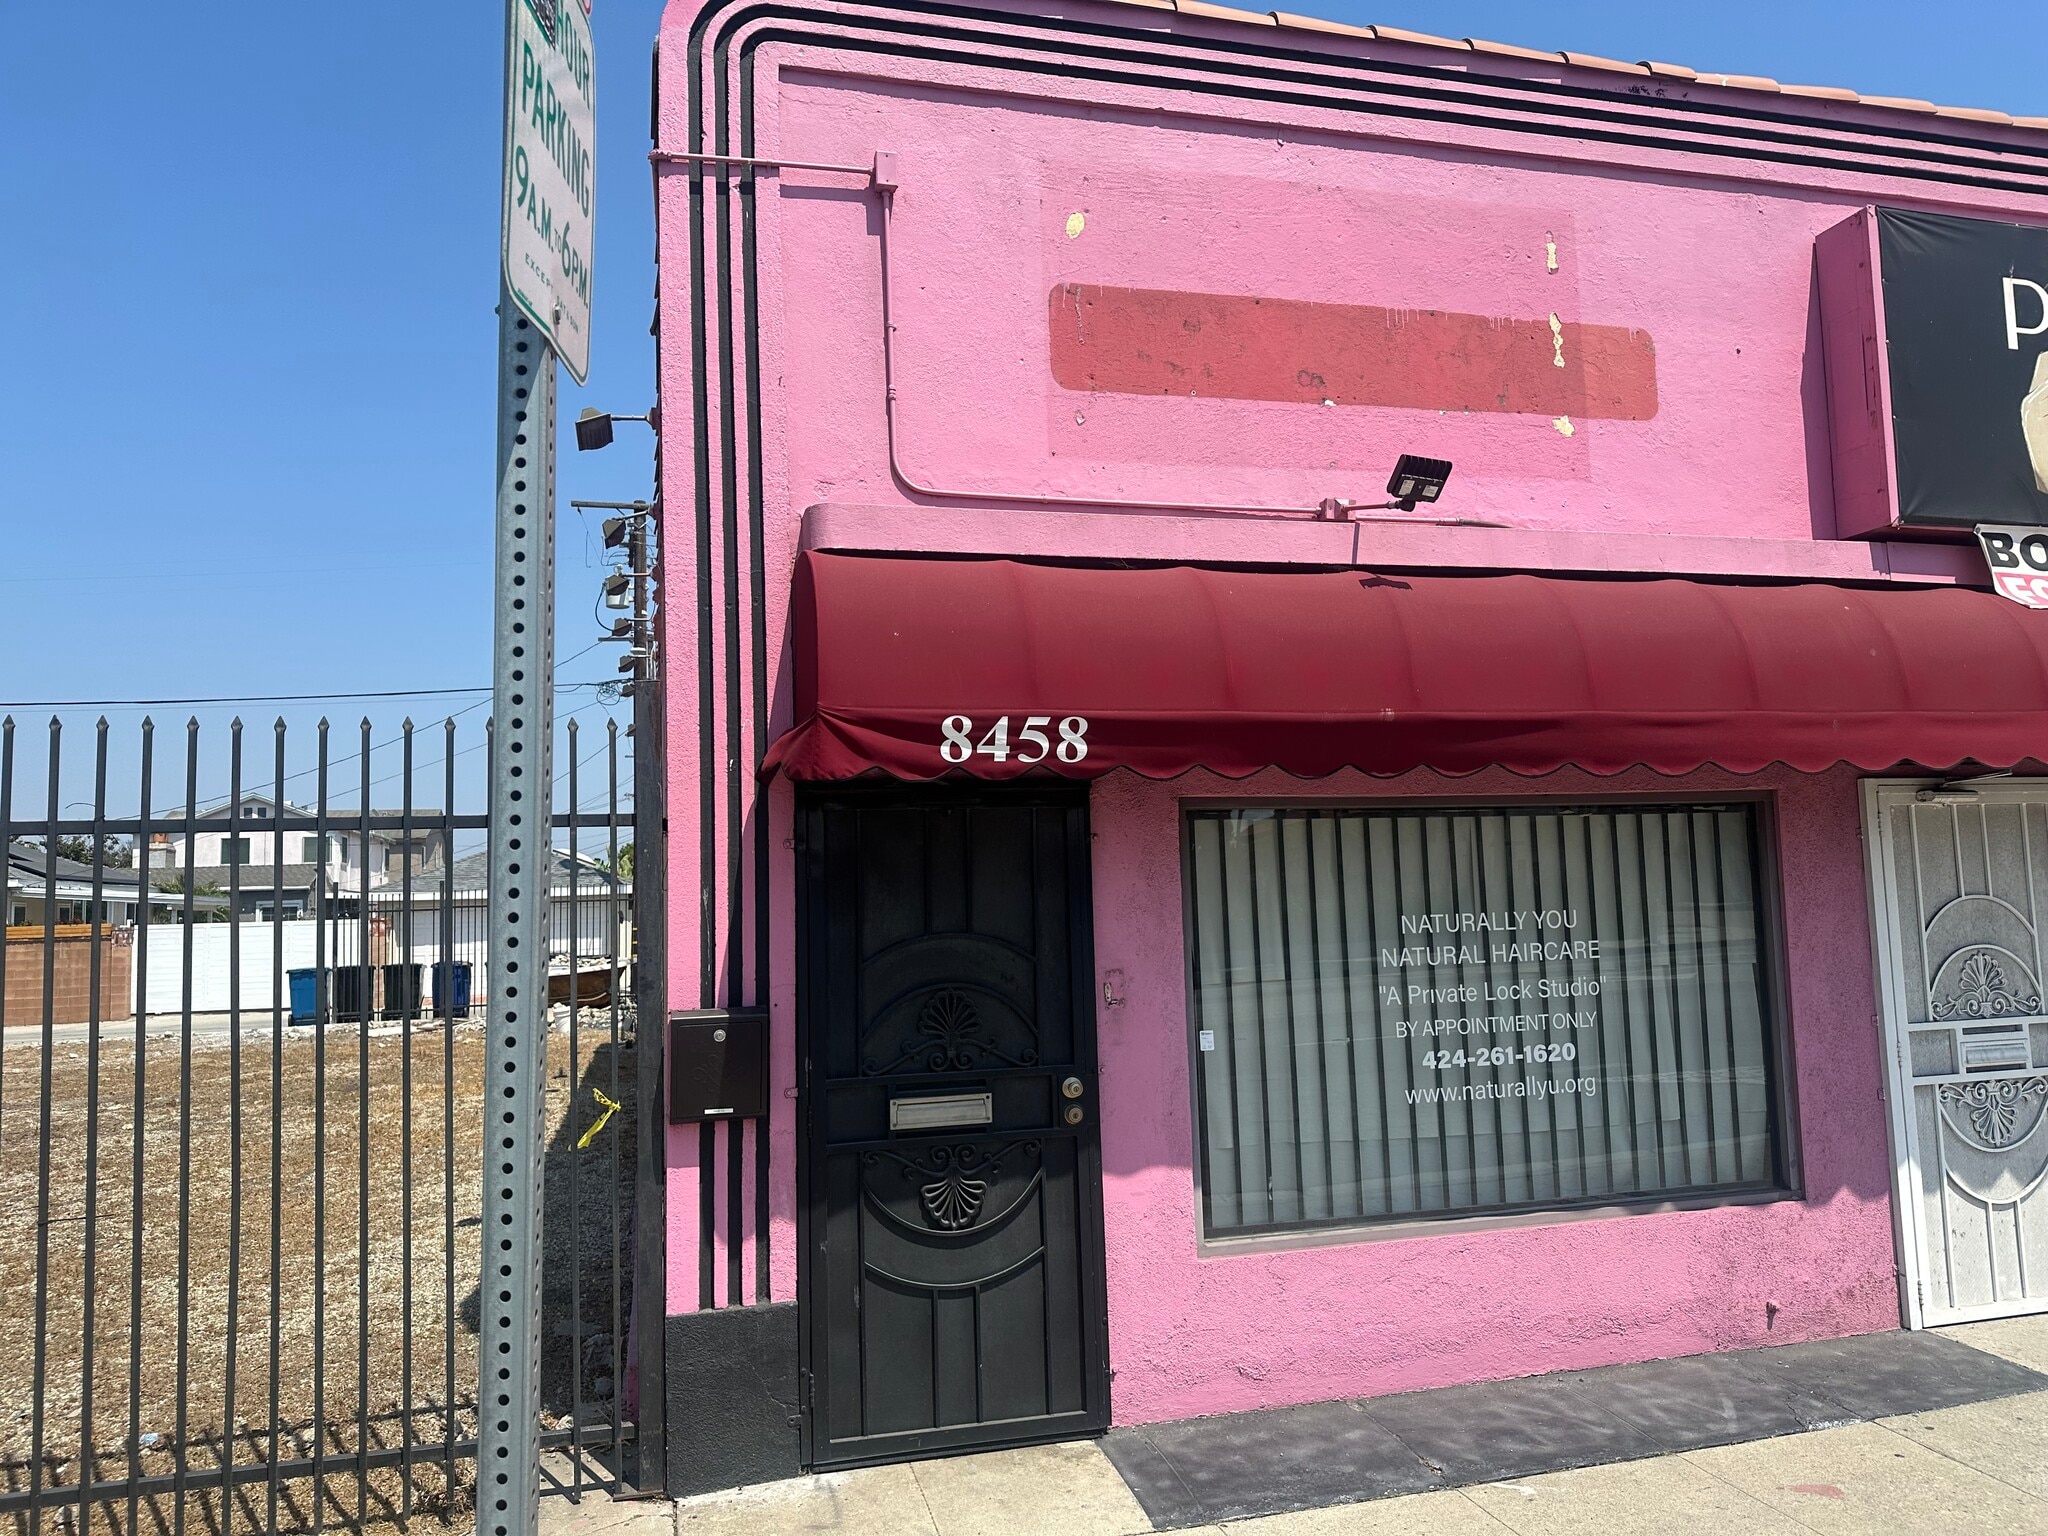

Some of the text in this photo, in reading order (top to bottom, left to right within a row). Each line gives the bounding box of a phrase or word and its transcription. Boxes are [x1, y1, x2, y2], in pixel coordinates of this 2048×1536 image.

[556, 0, 590, 110] HOUR
[522, 38, 589, 218] PARKING
[939, 714, 1089, 763] 8458
[1401, 909, 1578, 934] NATURALLY YOU
[1382, 940, 1601, 968] NATURAL HAIRCARE
[1379, 975, 1608, 1006] "A Private Lock Studio"
[1395, 1011, 1598, 1038] BY APPOINTMENT ONLY
[1422, 1042, 1576, 1070] 424-261-1620
[1405, 1076, 1596, 1105] www.naturallyu.org
